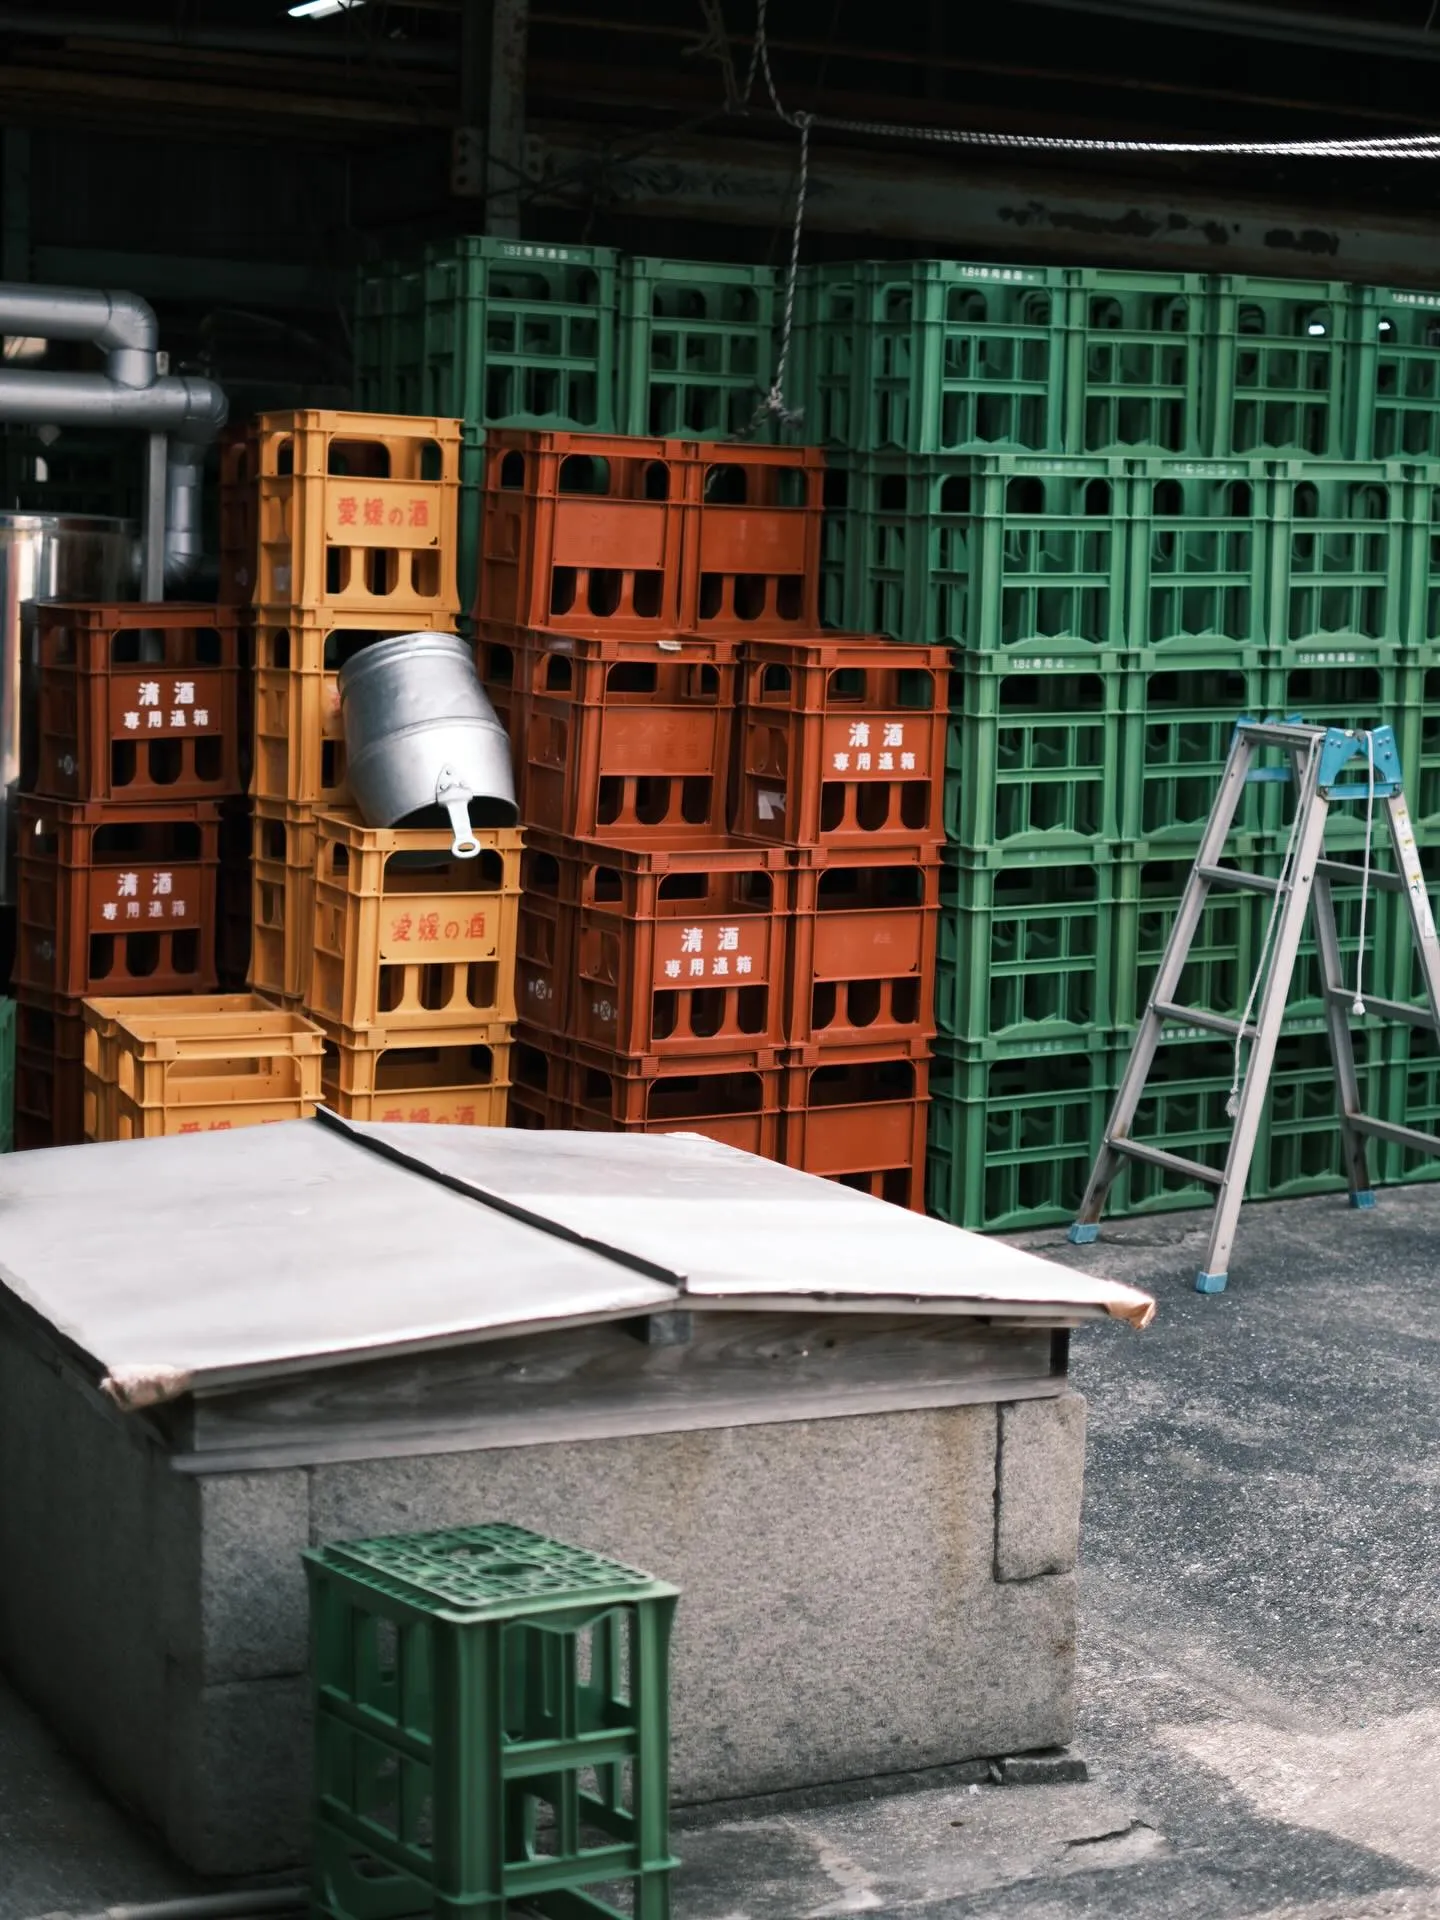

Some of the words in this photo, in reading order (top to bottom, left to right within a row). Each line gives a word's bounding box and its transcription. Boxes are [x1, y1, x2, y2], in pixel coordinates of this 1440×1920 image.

[337, 496, 429, 527] 愛媛の酒
[138, 681, 195, 706] 清酒
[123, 709, 209, 730] 専用通箱
[848, 721, 905, 748] 清酒
[832, 751, 916, 772] 専用通箱
[117, 872, 173, 897] 清酒
[390, 911, 486, 942] 愛媛の酒
[681, 926, 740, 953] 清酒
[664, 955, 753, 978] 専用通箱
